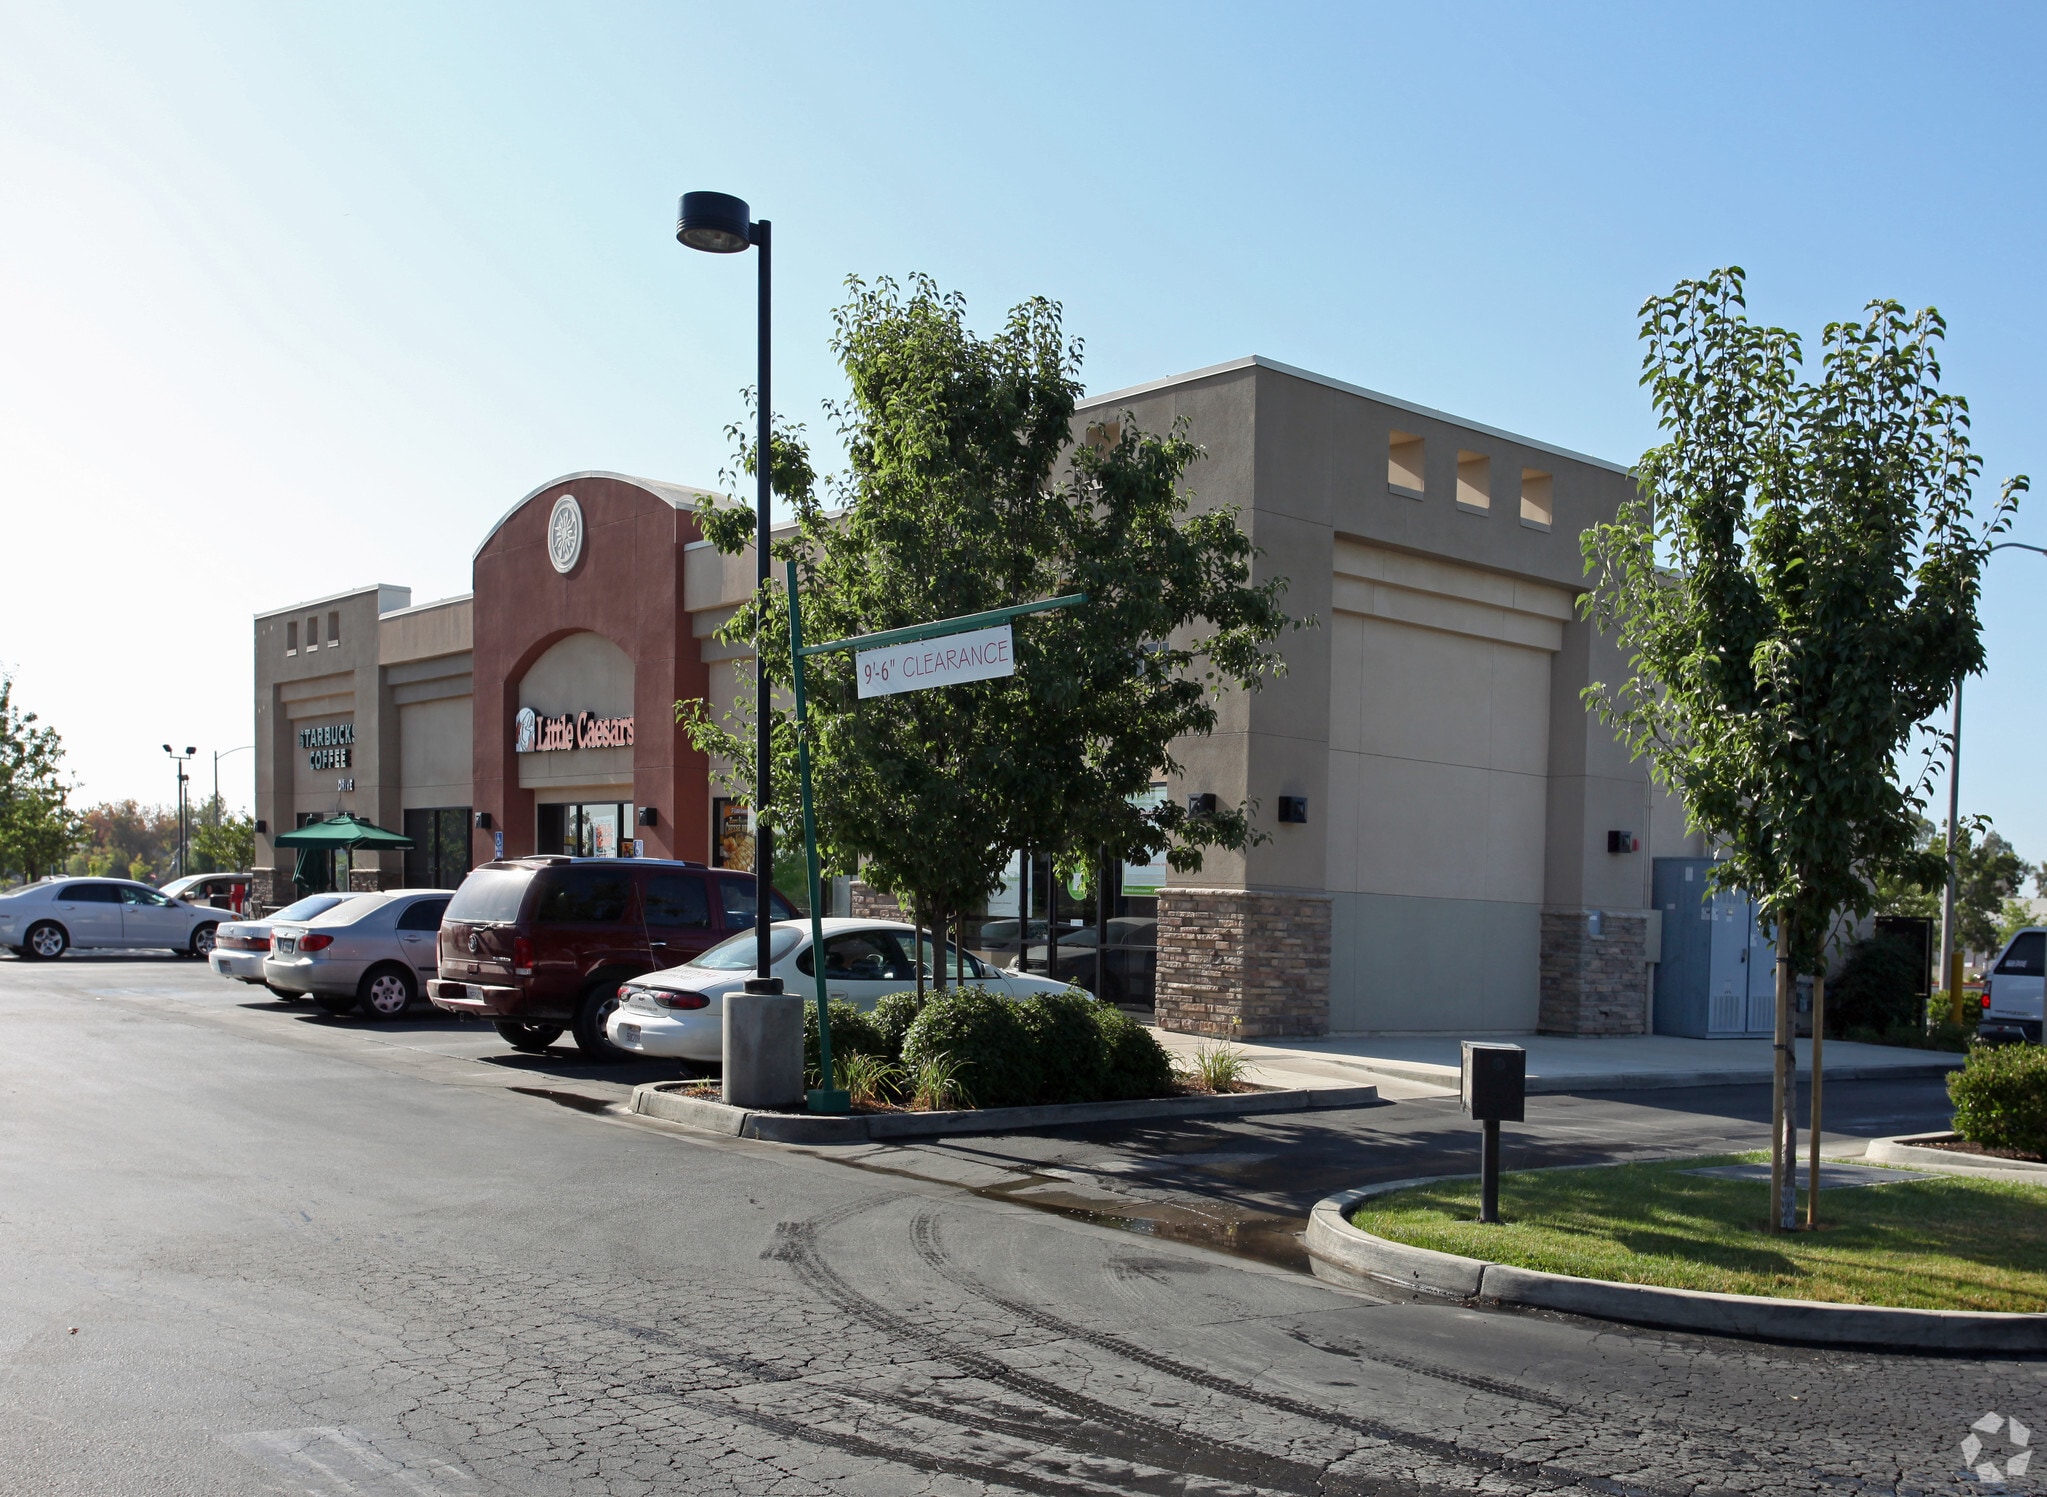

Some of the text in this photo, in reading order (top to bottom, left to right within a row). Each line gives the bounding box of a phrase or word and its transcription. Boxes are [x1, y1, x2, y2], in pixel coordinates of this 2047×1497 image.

[902, 640, 1009, 678] CLEARANCE
[536, 710, 634, 751] Little Caesars
[309, 748, 347, 770] COFFEE
